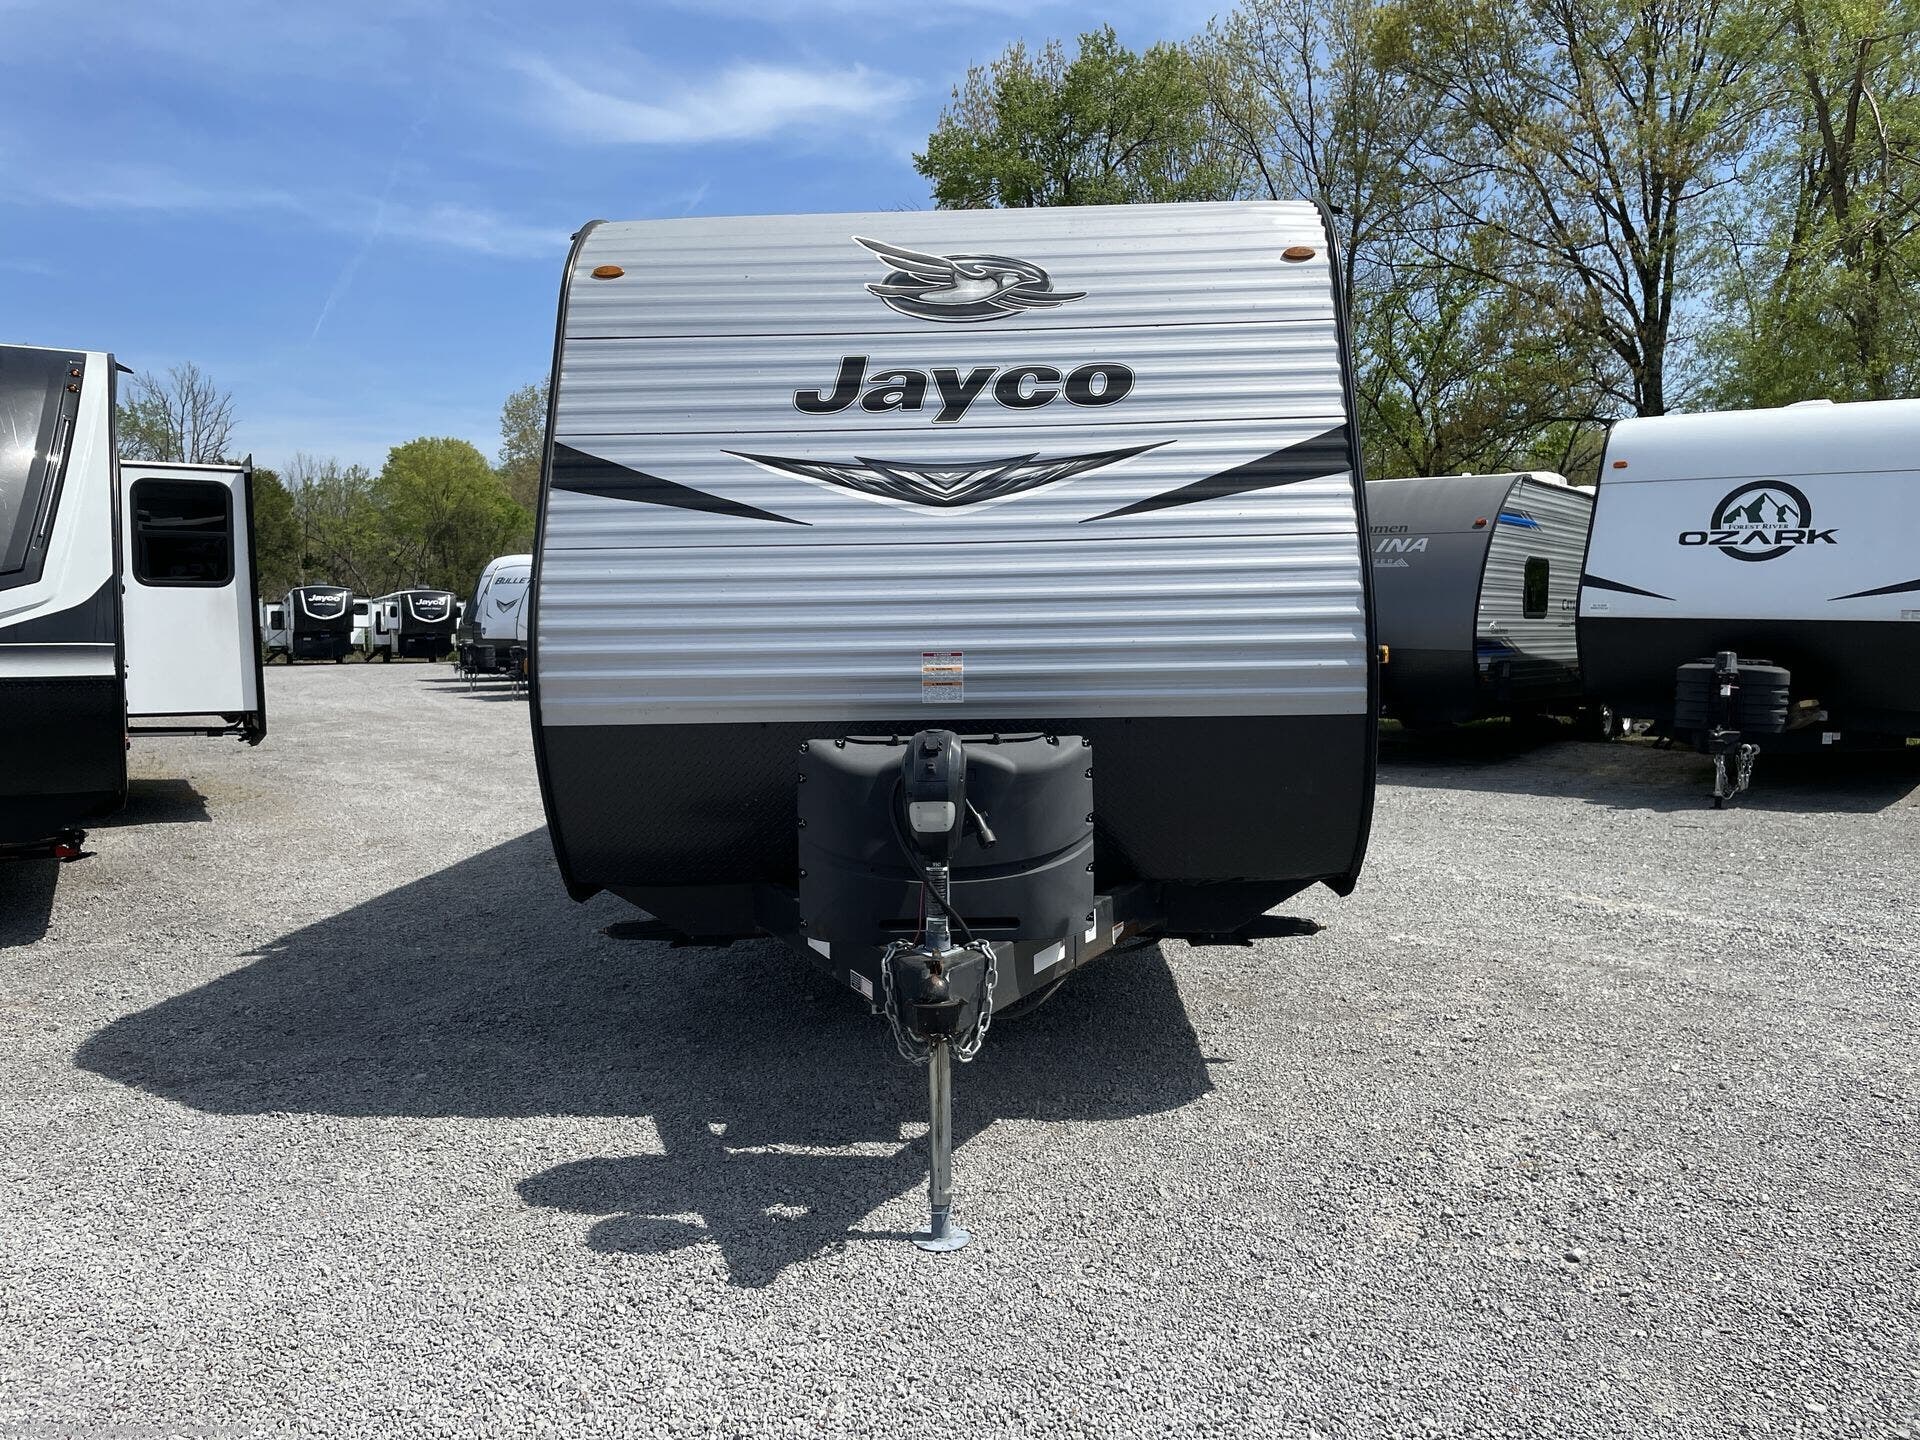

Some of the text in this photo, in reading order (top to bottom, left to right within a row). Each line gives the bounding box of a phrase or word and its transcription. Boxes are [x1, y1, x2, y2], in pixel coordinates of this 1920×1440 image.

[793, 354, 1135, 424] Jayco
[1372, 537, 1429, 552] INA
[1679, 528, 1840, 546] OZARK
[308, 594, 341, 603] Jayco
[415, 598, 445, 607] Jayco
